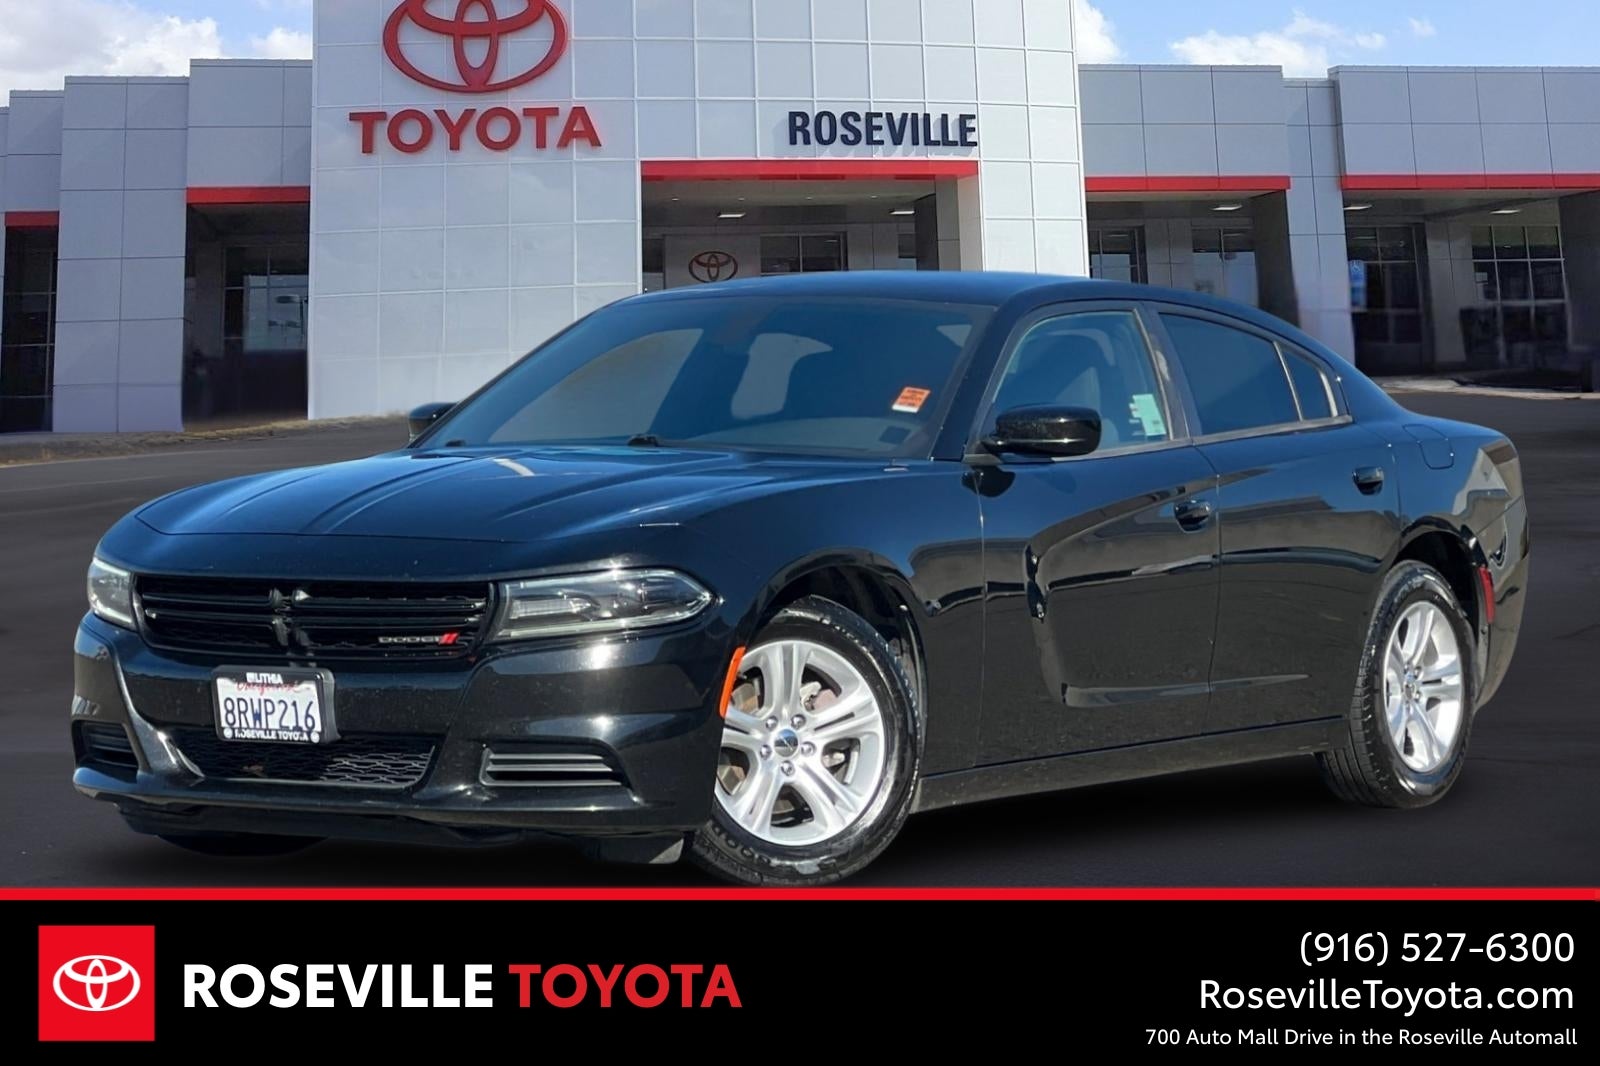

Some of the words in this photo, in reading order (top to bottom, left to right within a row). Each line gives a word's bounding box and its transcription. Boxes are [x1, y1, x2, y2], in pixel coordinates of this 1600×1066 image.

[349, 106, 602, 154] TOYOTA
[788, 111, 978, 148] ROSEVILLE
[223, 696, 316, 731] 8RWP216
